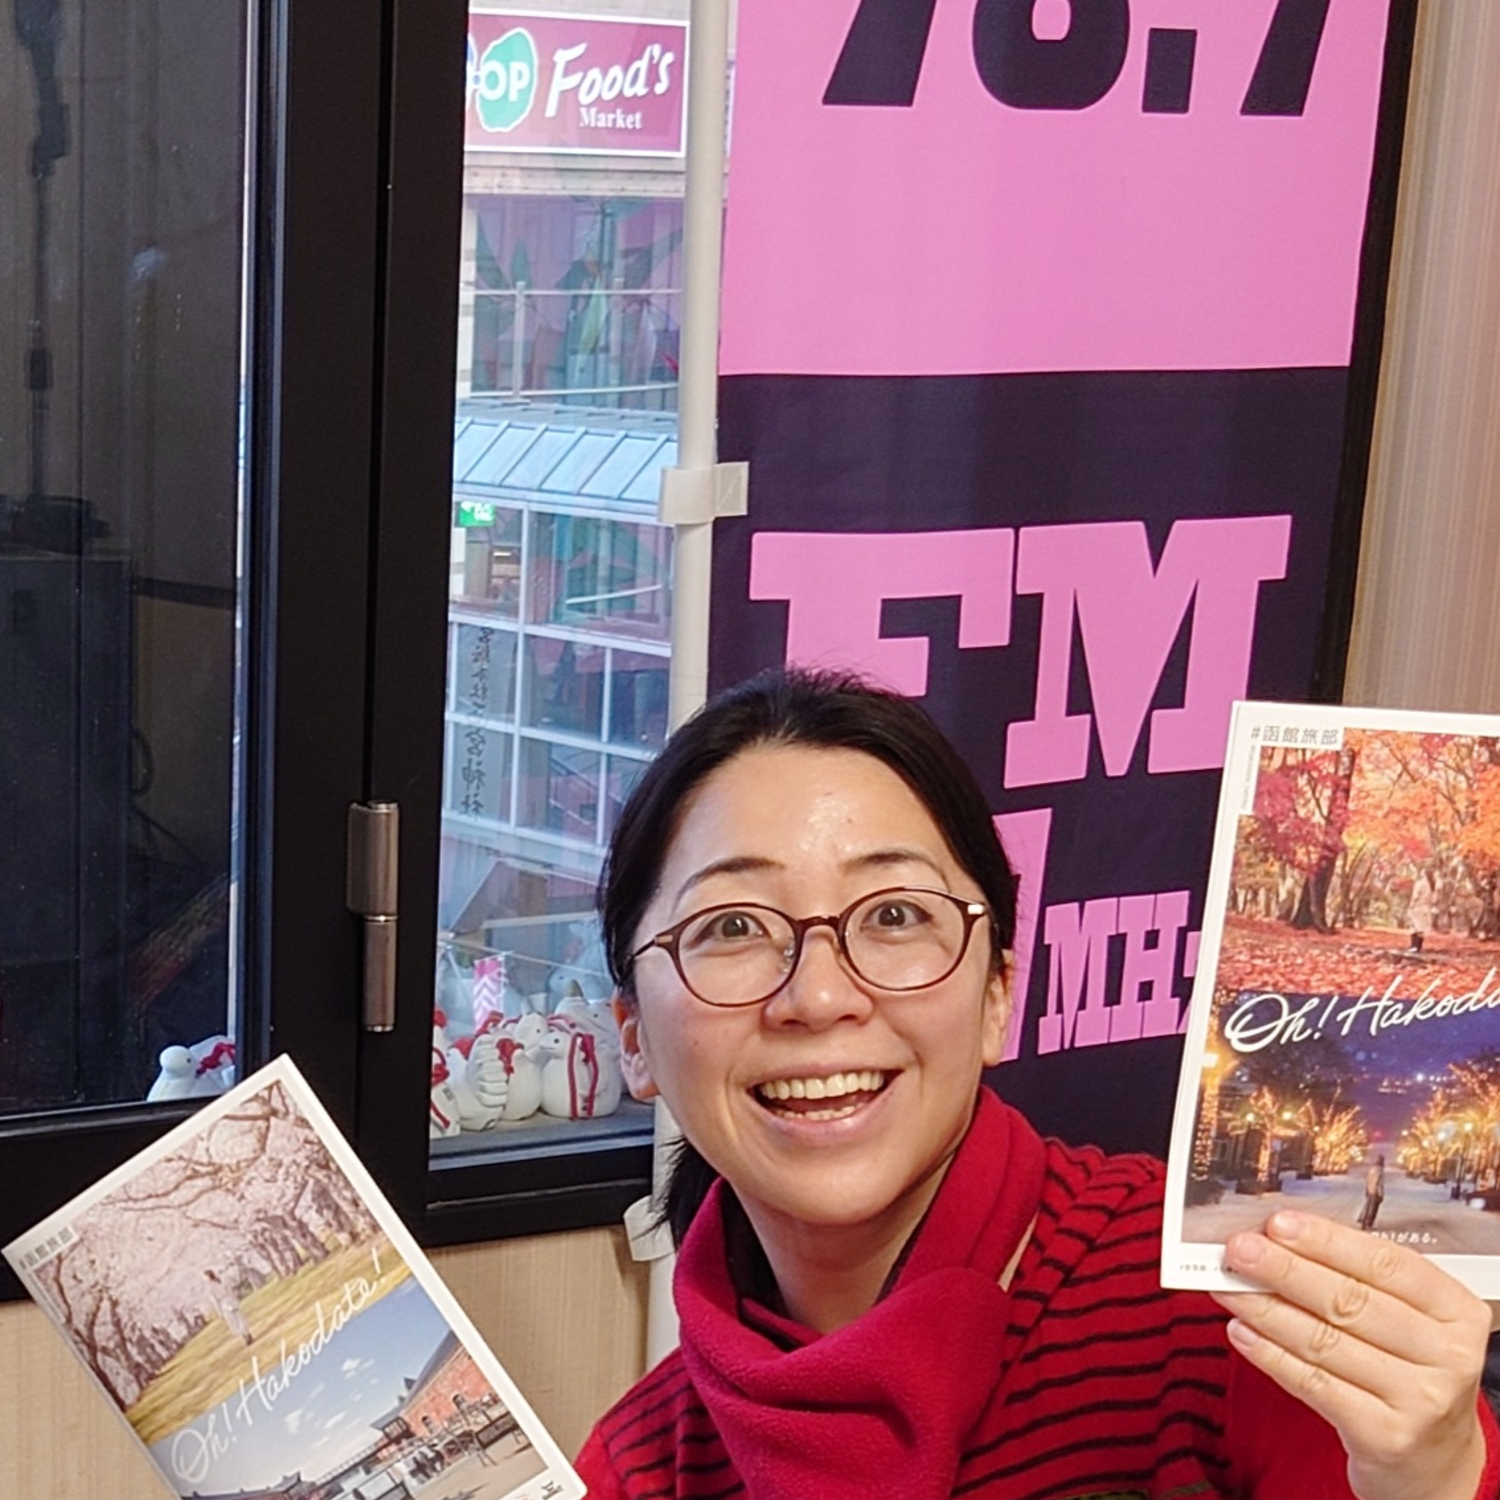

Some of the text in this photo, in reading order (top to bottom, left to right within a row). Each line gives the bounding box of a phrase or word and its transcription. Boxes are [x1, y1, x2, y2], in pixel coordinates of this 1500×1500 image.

[545, 43, 675, 118] Food's
[579, 107, 642, 129] Market
[749, 514, 1292, 790] FM
[1224, 993, 1340, 1053] Oh!
[171, 1246, 387, 1483] Oh! Hakodate!
